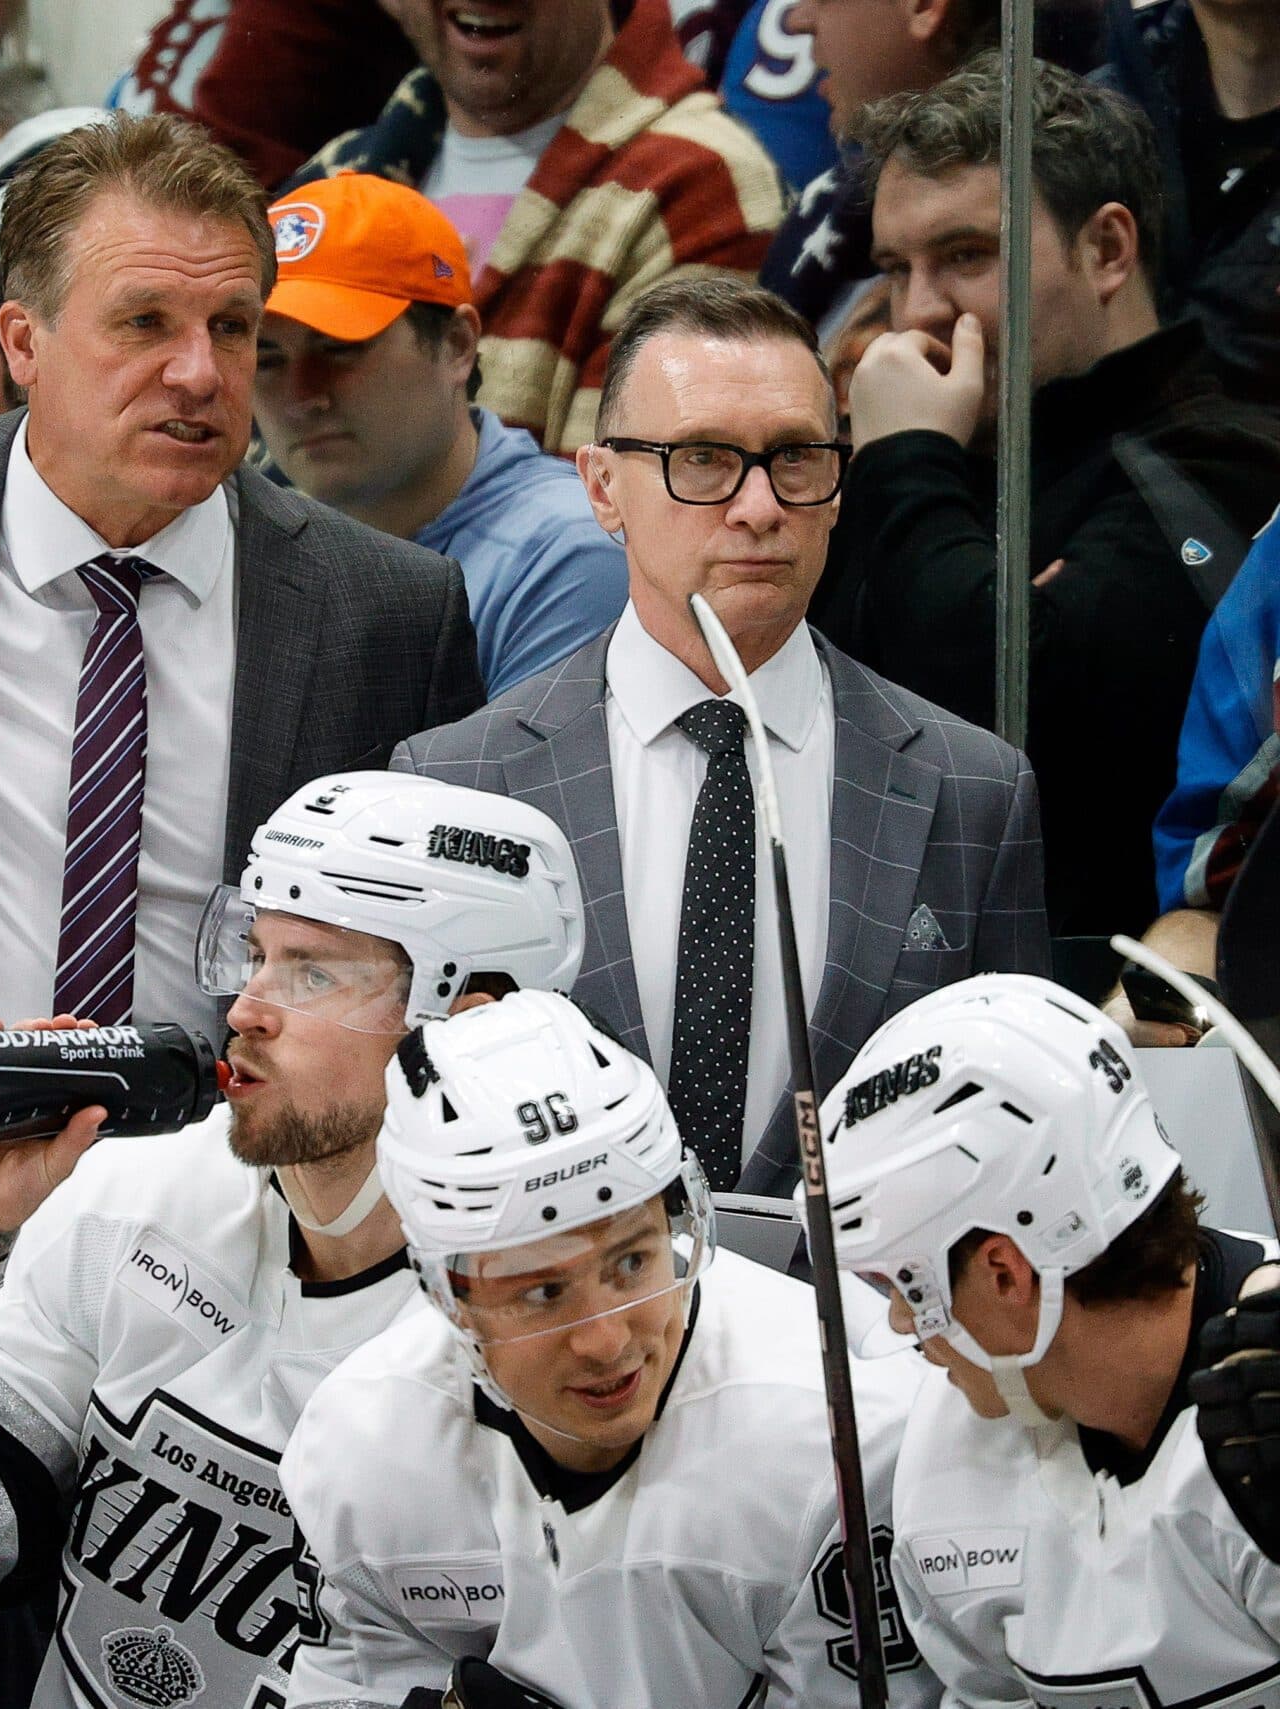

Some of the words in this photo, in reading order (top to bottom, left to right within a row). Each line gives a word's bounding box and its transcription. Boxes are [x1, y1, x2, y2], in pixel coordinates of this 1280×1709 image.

[427, 825, 531, 878] KINGS
[60, 1047, 105, 1061] Sports
[108, 1046, 146, 1059] Drink
[843, 1045, 942, 1129] KINGS
[515, 1090, 579, 1146] 96
[798, 1100, 821, 1185] CCM
[524, 1153, 608, 1193] BAUER
[131, 1249, 183, 1291] IRON
[186, 1288, 235, 1334] BOW
[151, 1431, 197, 1473] Los
[196, 1459, 293, 1517] Angele
[71, 1434, 301, 1673] KING
[919, 1554, 958, 1574] IRON
[967, 1549, 1019, 1567] BOW
[402, 1586, 456, 1600] IRON
